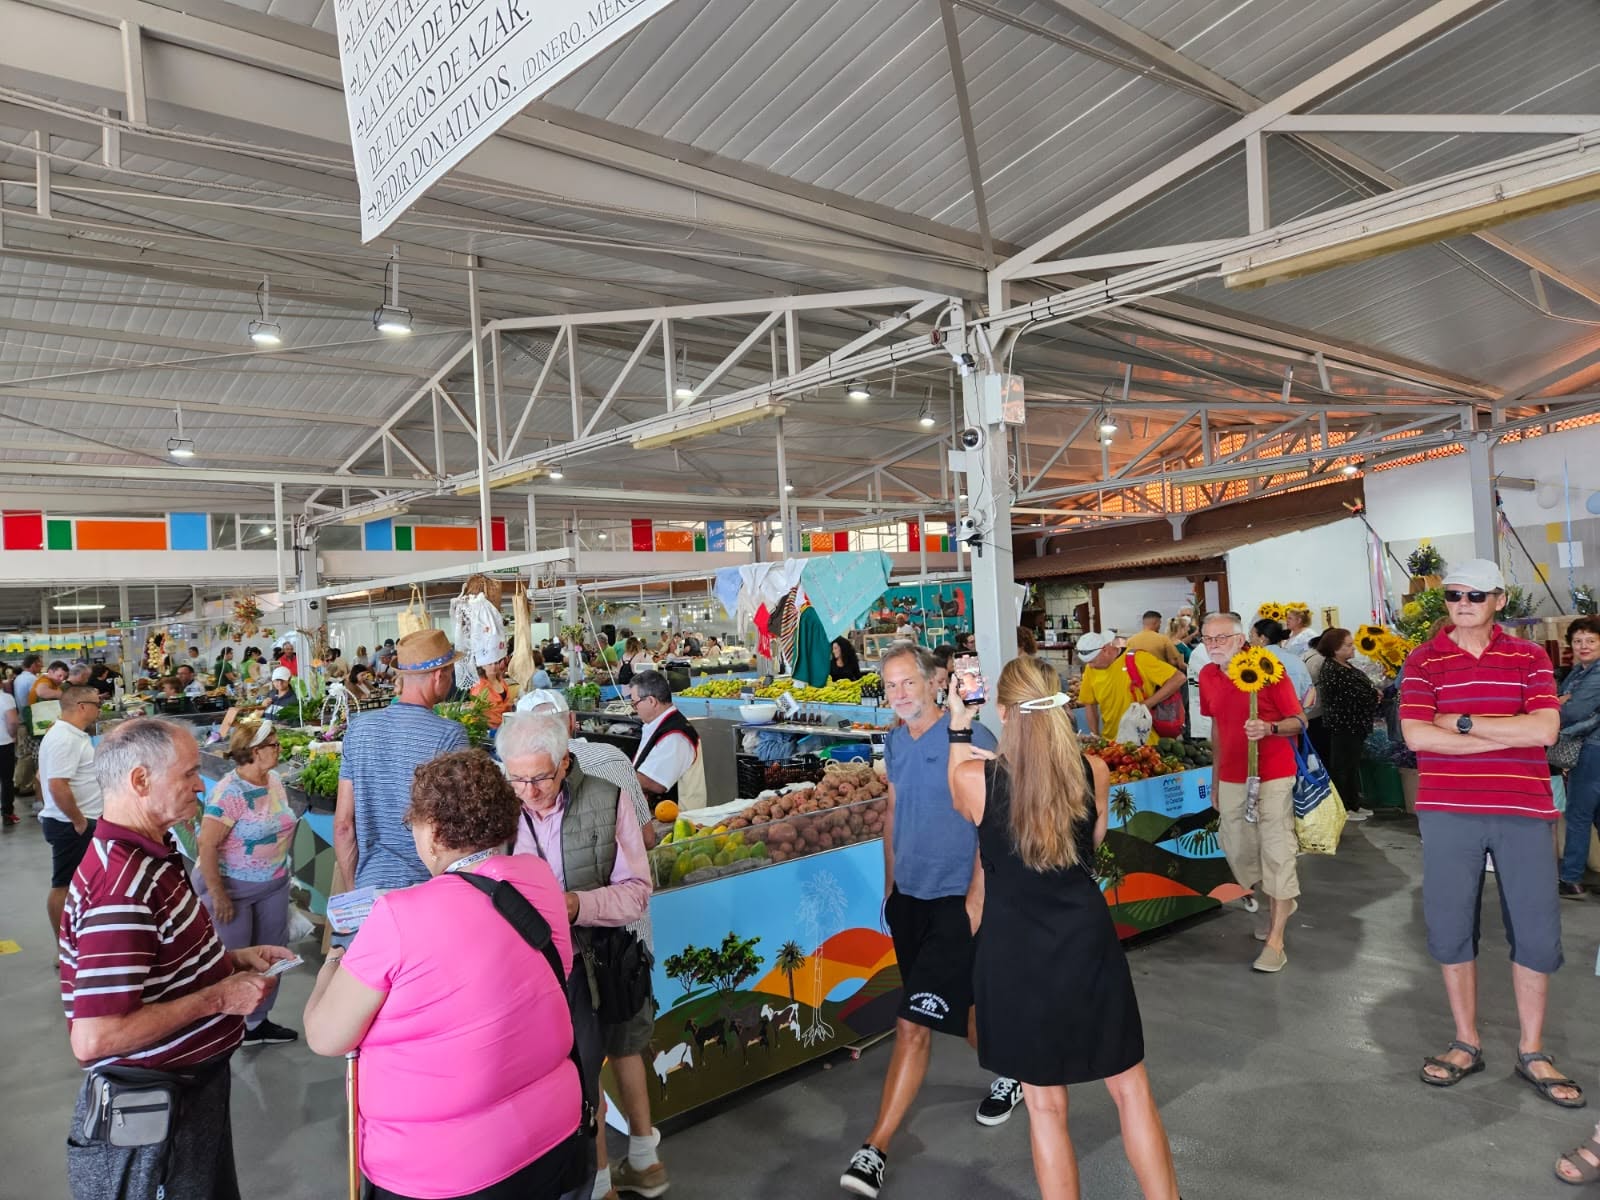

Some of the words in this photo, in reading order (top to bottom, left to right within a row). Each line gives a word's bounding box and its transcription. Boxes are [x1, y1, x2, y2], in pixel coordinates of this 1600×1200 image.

[349, 8, 365, 46] LA
[355, 52, 371, 89] LA
[370, 0, 414, 60] VENTA
[362, 95, 378, 132] LA
[376, 37, 422, 107] VENTA
[421, 4, 446, 54] DE
[368, 136, 387, 174] DE
[386, 75, 436, 155] JUEGOS
[438, 46, 463, 95] DE
[468, 0, 530, 70] AZAR.
[375, 161, 412, 217] PEDIR
[411, 64, 517, 178] DONATIVOS.
